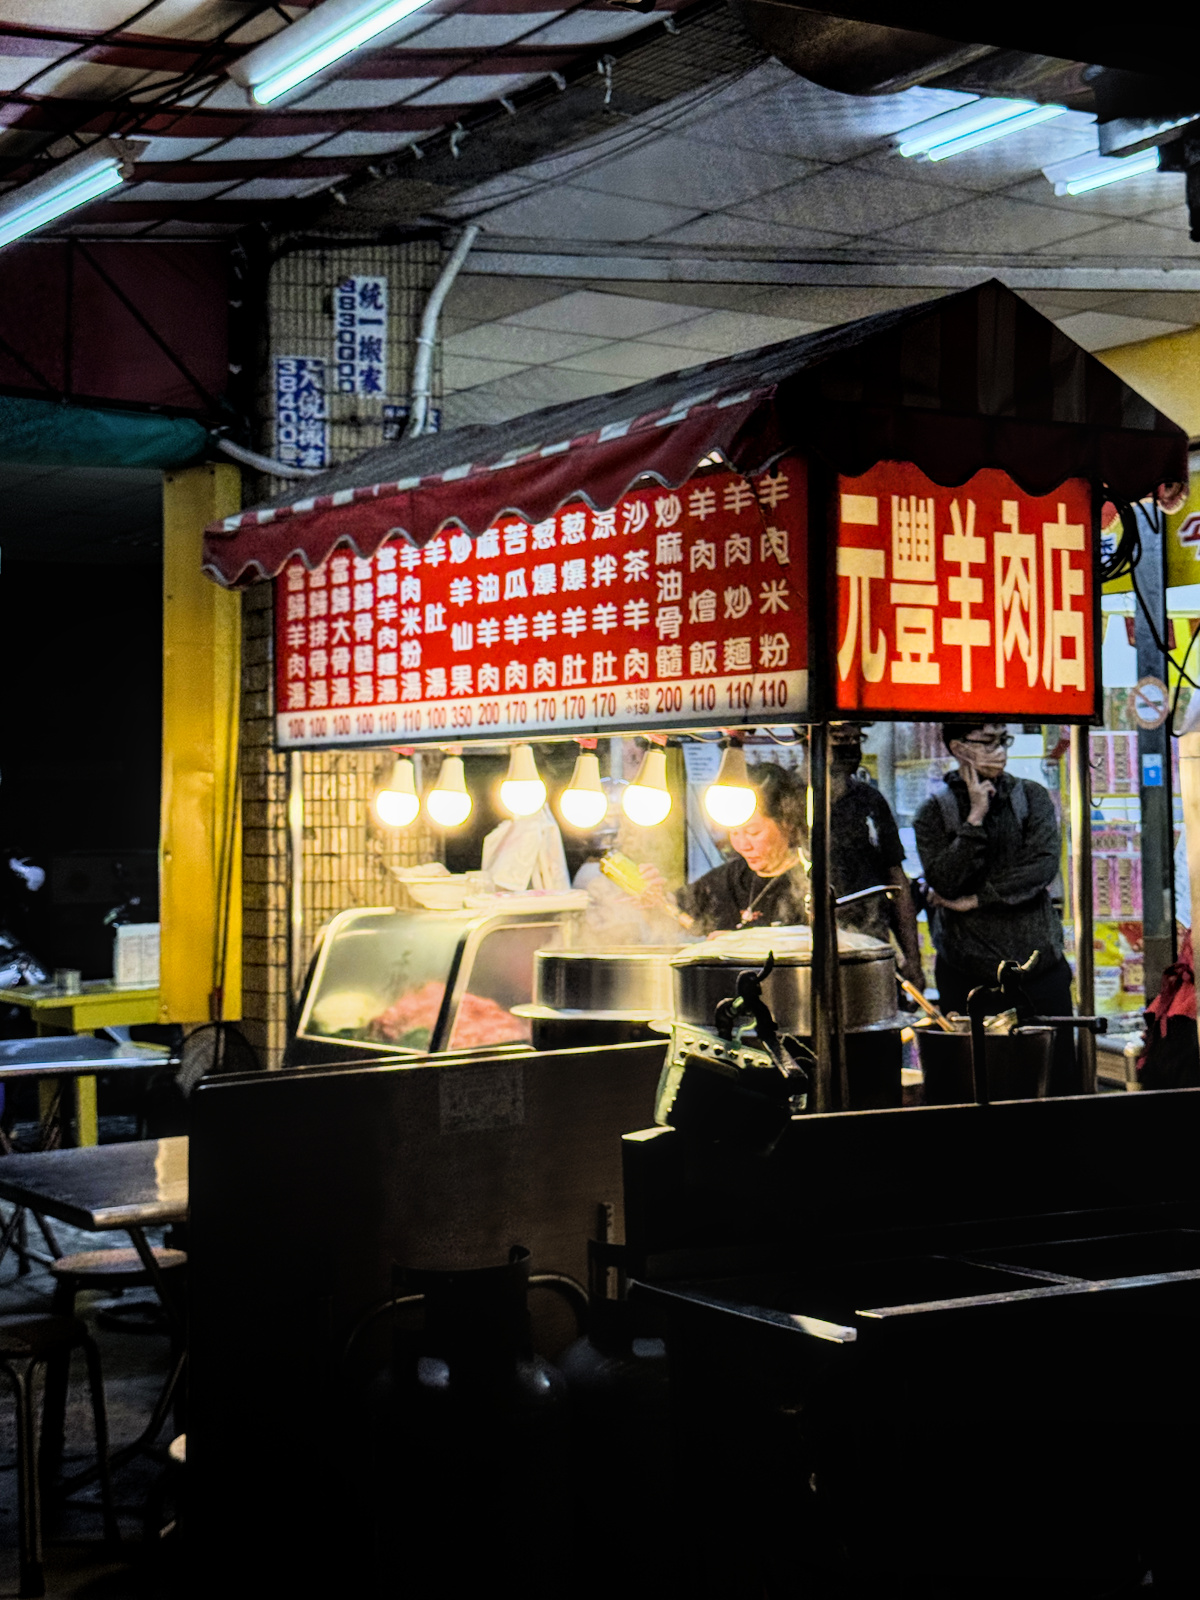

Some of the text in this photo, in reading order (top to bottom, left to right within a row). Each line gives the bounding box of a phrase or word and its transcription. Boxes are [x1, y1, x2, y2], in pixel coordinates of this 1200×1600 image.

[357, 282, 384, 394] 統一搬家
[400, 544, 422, 702] 羊肉米粉湯
[424, 538, 447, 698] 羊肚湯
[476, 528, 500, 693] 麻油羊肉
[503, 522, 529, 691] 苦瓜羊肉
[622, 499, 650, 681] 沙茶羊肉
[655, 494, 683, 679] 炒麻油骨髓
[689, 486, 717, 675] 羊肉燴飯
[723, 479, 753, 672] 羊肉炒麵
[759, 471, 790, 668] 羊肉米粉
[836, 493, 1086, 693] 元豐羊肉店
[288, 679, 788, 739] 100 100 100 100 110 110 100 350 200 170 170 170 170 200 110 110 110
